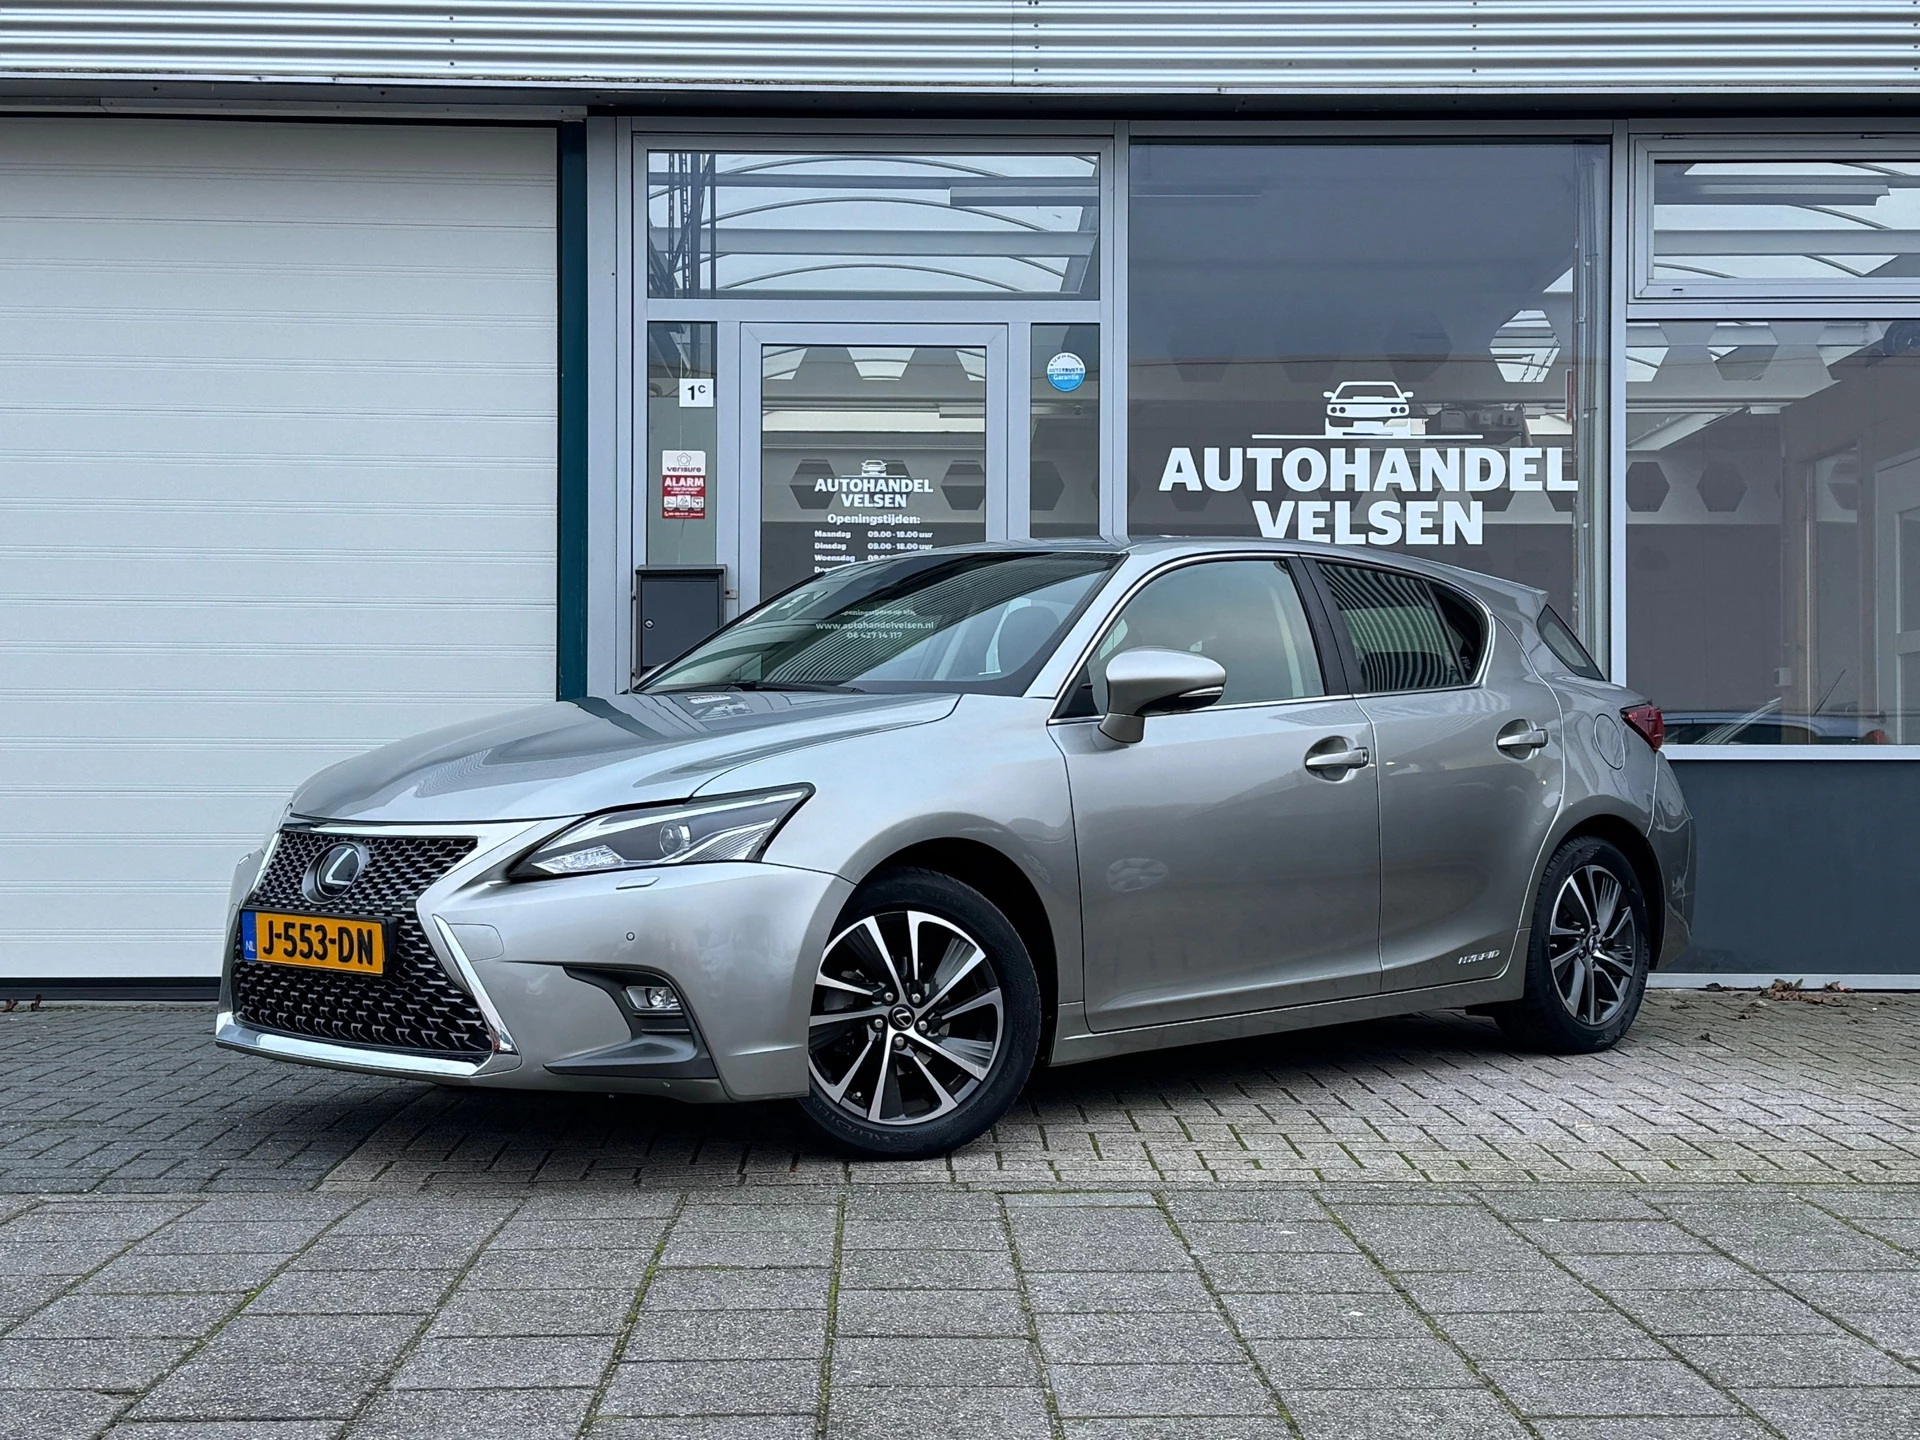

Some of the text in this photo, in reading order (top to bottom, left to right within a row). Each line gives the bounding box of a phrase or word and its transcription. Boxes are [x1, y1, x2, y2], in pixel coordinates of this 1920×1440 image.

[1158, 447, 1578, 492] AUTOHANDEL
[664, 477, 704, 487] ALARM
[814, 478, 934, 492] AUTOHANDEL
[841, 493, 907, 507] VELSEN
[827, 513, 921, 525] Openingstijden:
[1252, 500, 1483, 545] VELSEN
[814, 530, 851, 538] Maandag
[814, 542, 847, 550] Dinsdag
[814, 554, 856, 563] Woensdag
[245, 920, 373, 965] NL J-553-DN
